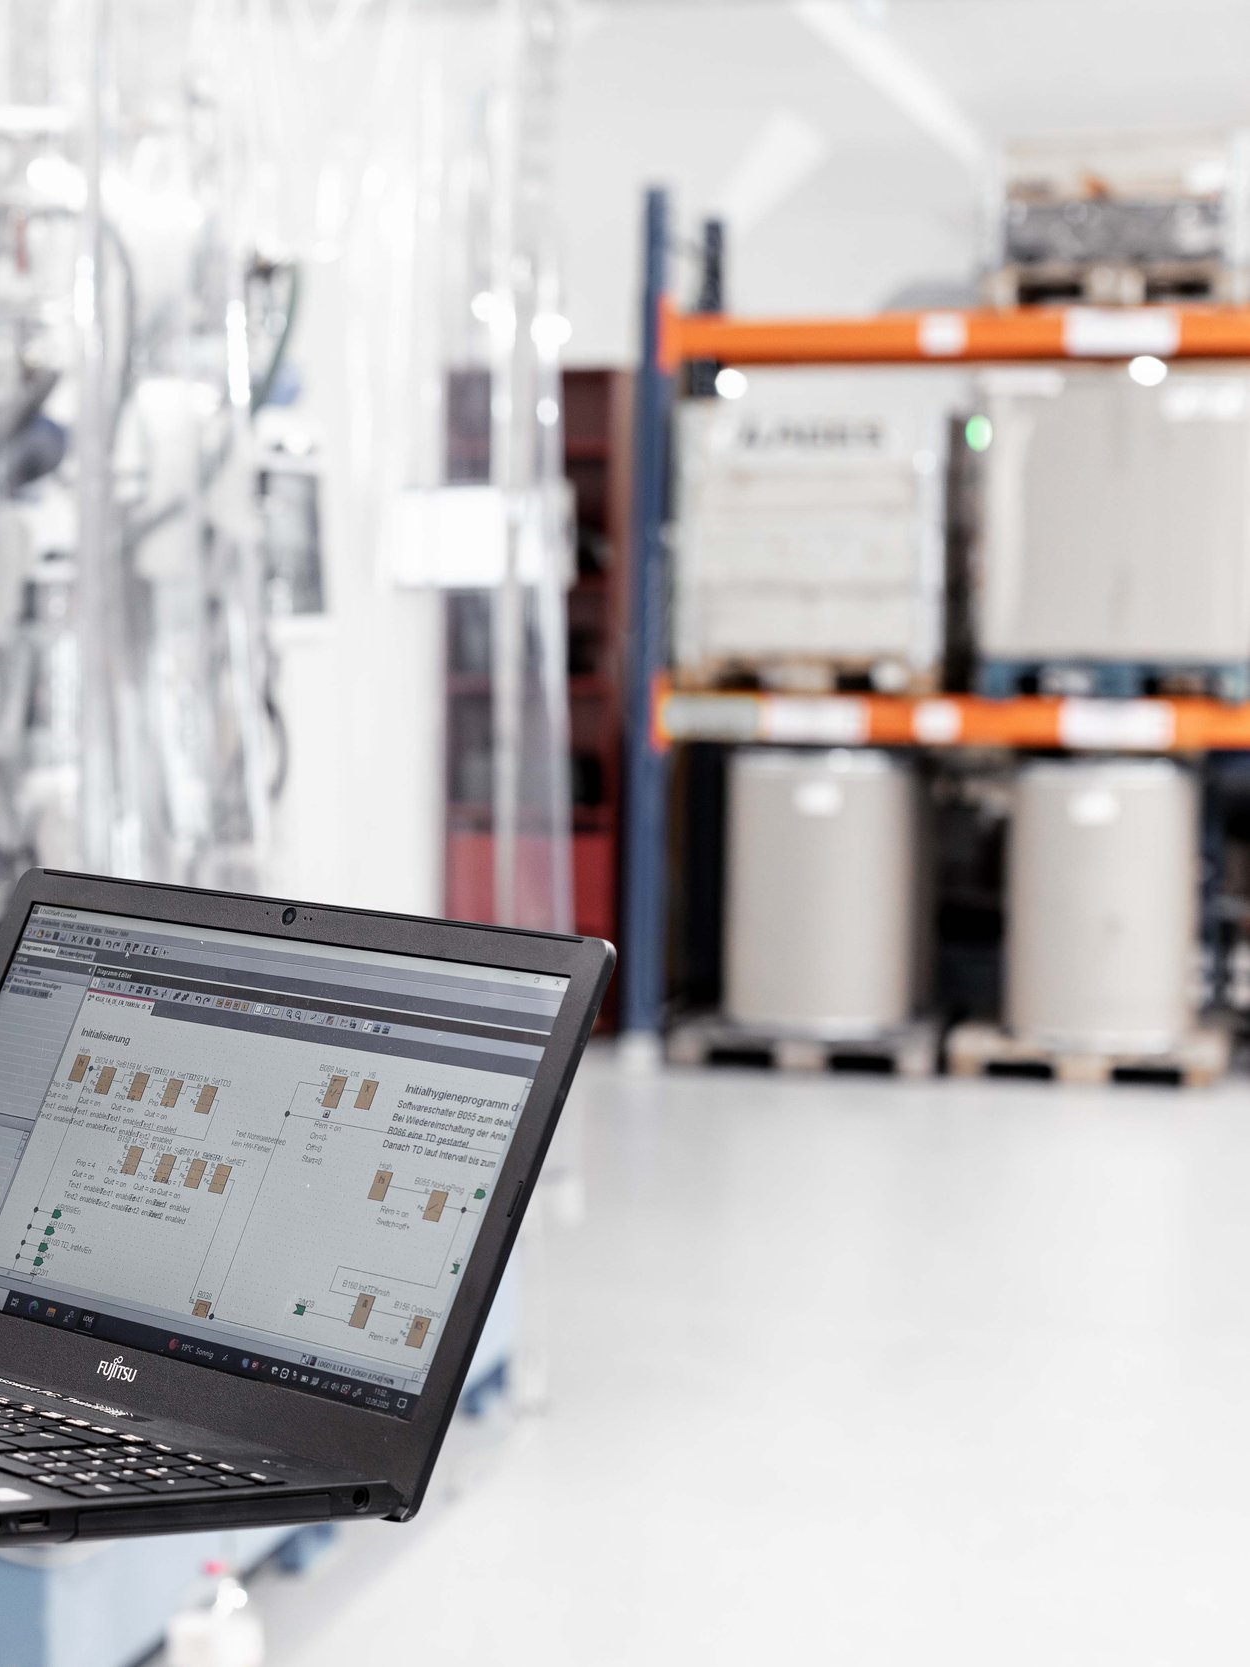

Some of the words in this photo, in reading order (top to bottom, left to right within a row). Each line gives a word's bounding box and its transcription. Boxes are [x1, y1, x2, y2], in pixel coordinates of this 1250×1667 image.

[80, 1028, 131, 1046] Initialisierung
[404, 1084, 510, 1112] Initialhygieneprogramm
[396, 1099, 456, 1117] Softwareschalter
[477, 1116, 492, 1124] zum
[313, 1121, 328, 1129] Rem
[392, 1113, 405, 1122] Bei
[404, 1115, 475, 1137] Wiedereinschaltung
[475, 1128, 489, 1137] der
[407, 1130, 423, 1139] eine
[424, 1133, 437, 1142] TD
[382, 1139, 410, 1152] Danach
[410, 1145, 423, 1154] TD
[423, 1147, 438, 1157] laut
[438, 1150, 467, 1162] Intervall
[467, 1155, 480, 1165] bis
[479, 1159, 496, 1168] zum
[379, 1205, 395, 1215] Rem
[368, 1331, 383, 1341] Rem
[194, 1347, 214, 1359] Sonnig
[97, 1356, 138, 1383] FUJITSU
